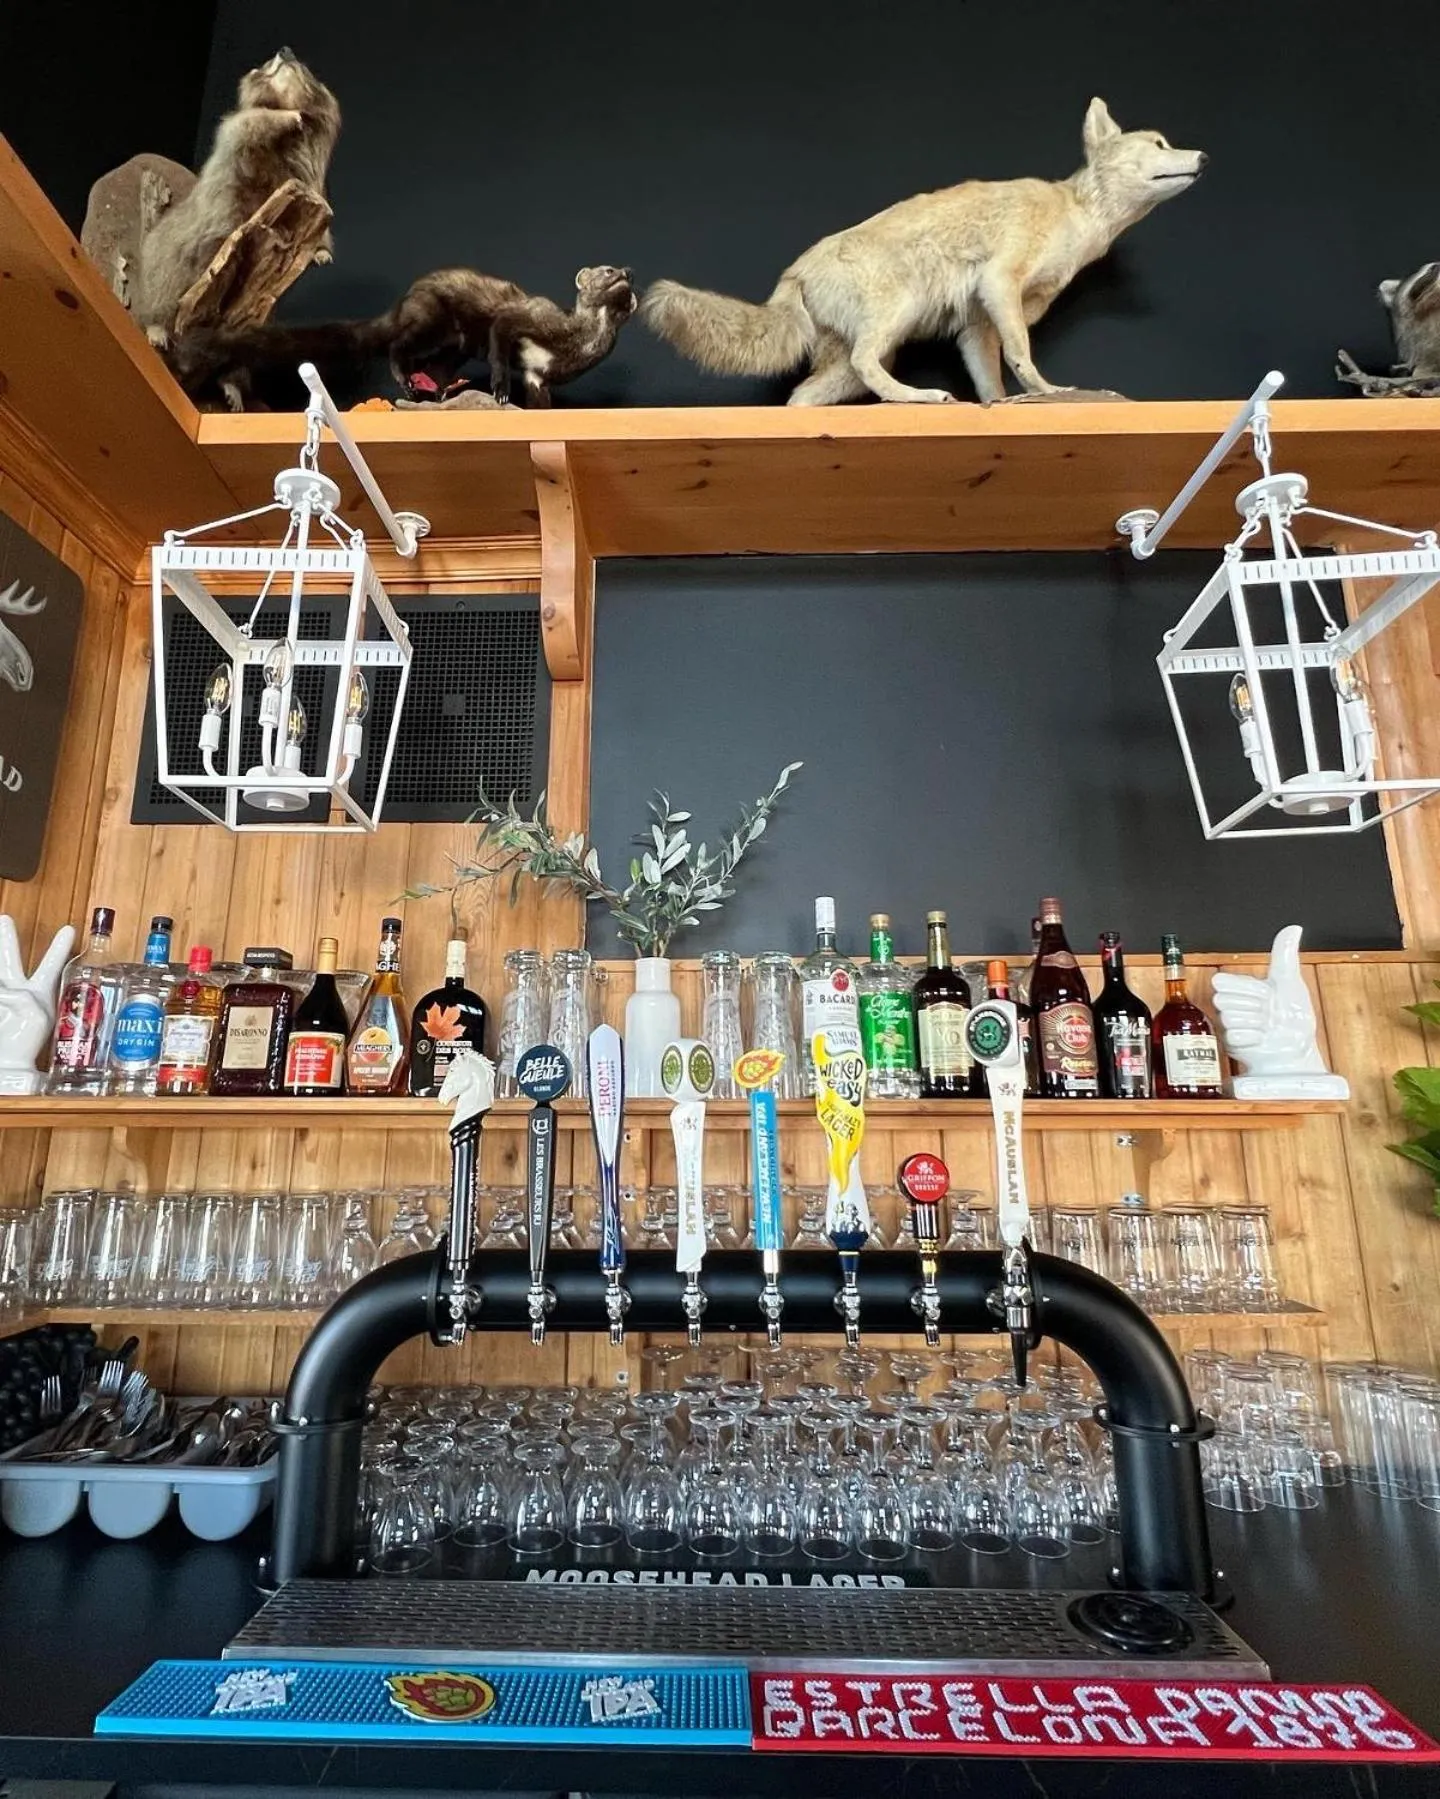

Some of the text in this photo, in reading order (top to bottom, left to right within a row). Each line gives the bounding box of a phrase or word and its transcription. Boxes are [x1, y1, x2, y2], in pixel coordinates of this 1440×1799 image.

[118, 1016, 163, 1034] maxi
[136, 1039, 155, 1047] GIN
[525, 1055, 561, 1070] BELLE
[819, 1057, 864, 1080] WICKED
[519, 1064, 565, 1085] GUEULE
[826, 1078, 863, 1107] easy
[820, 1107, 856, 1142] LAGER
[535, 1138, 545, 1157] LES
[533, 1156, 544, 1213] BRASSEURS
[590, 1686, 658, 1723] IPA
[764, 1679, 1131, 1715] ESTRELLA
